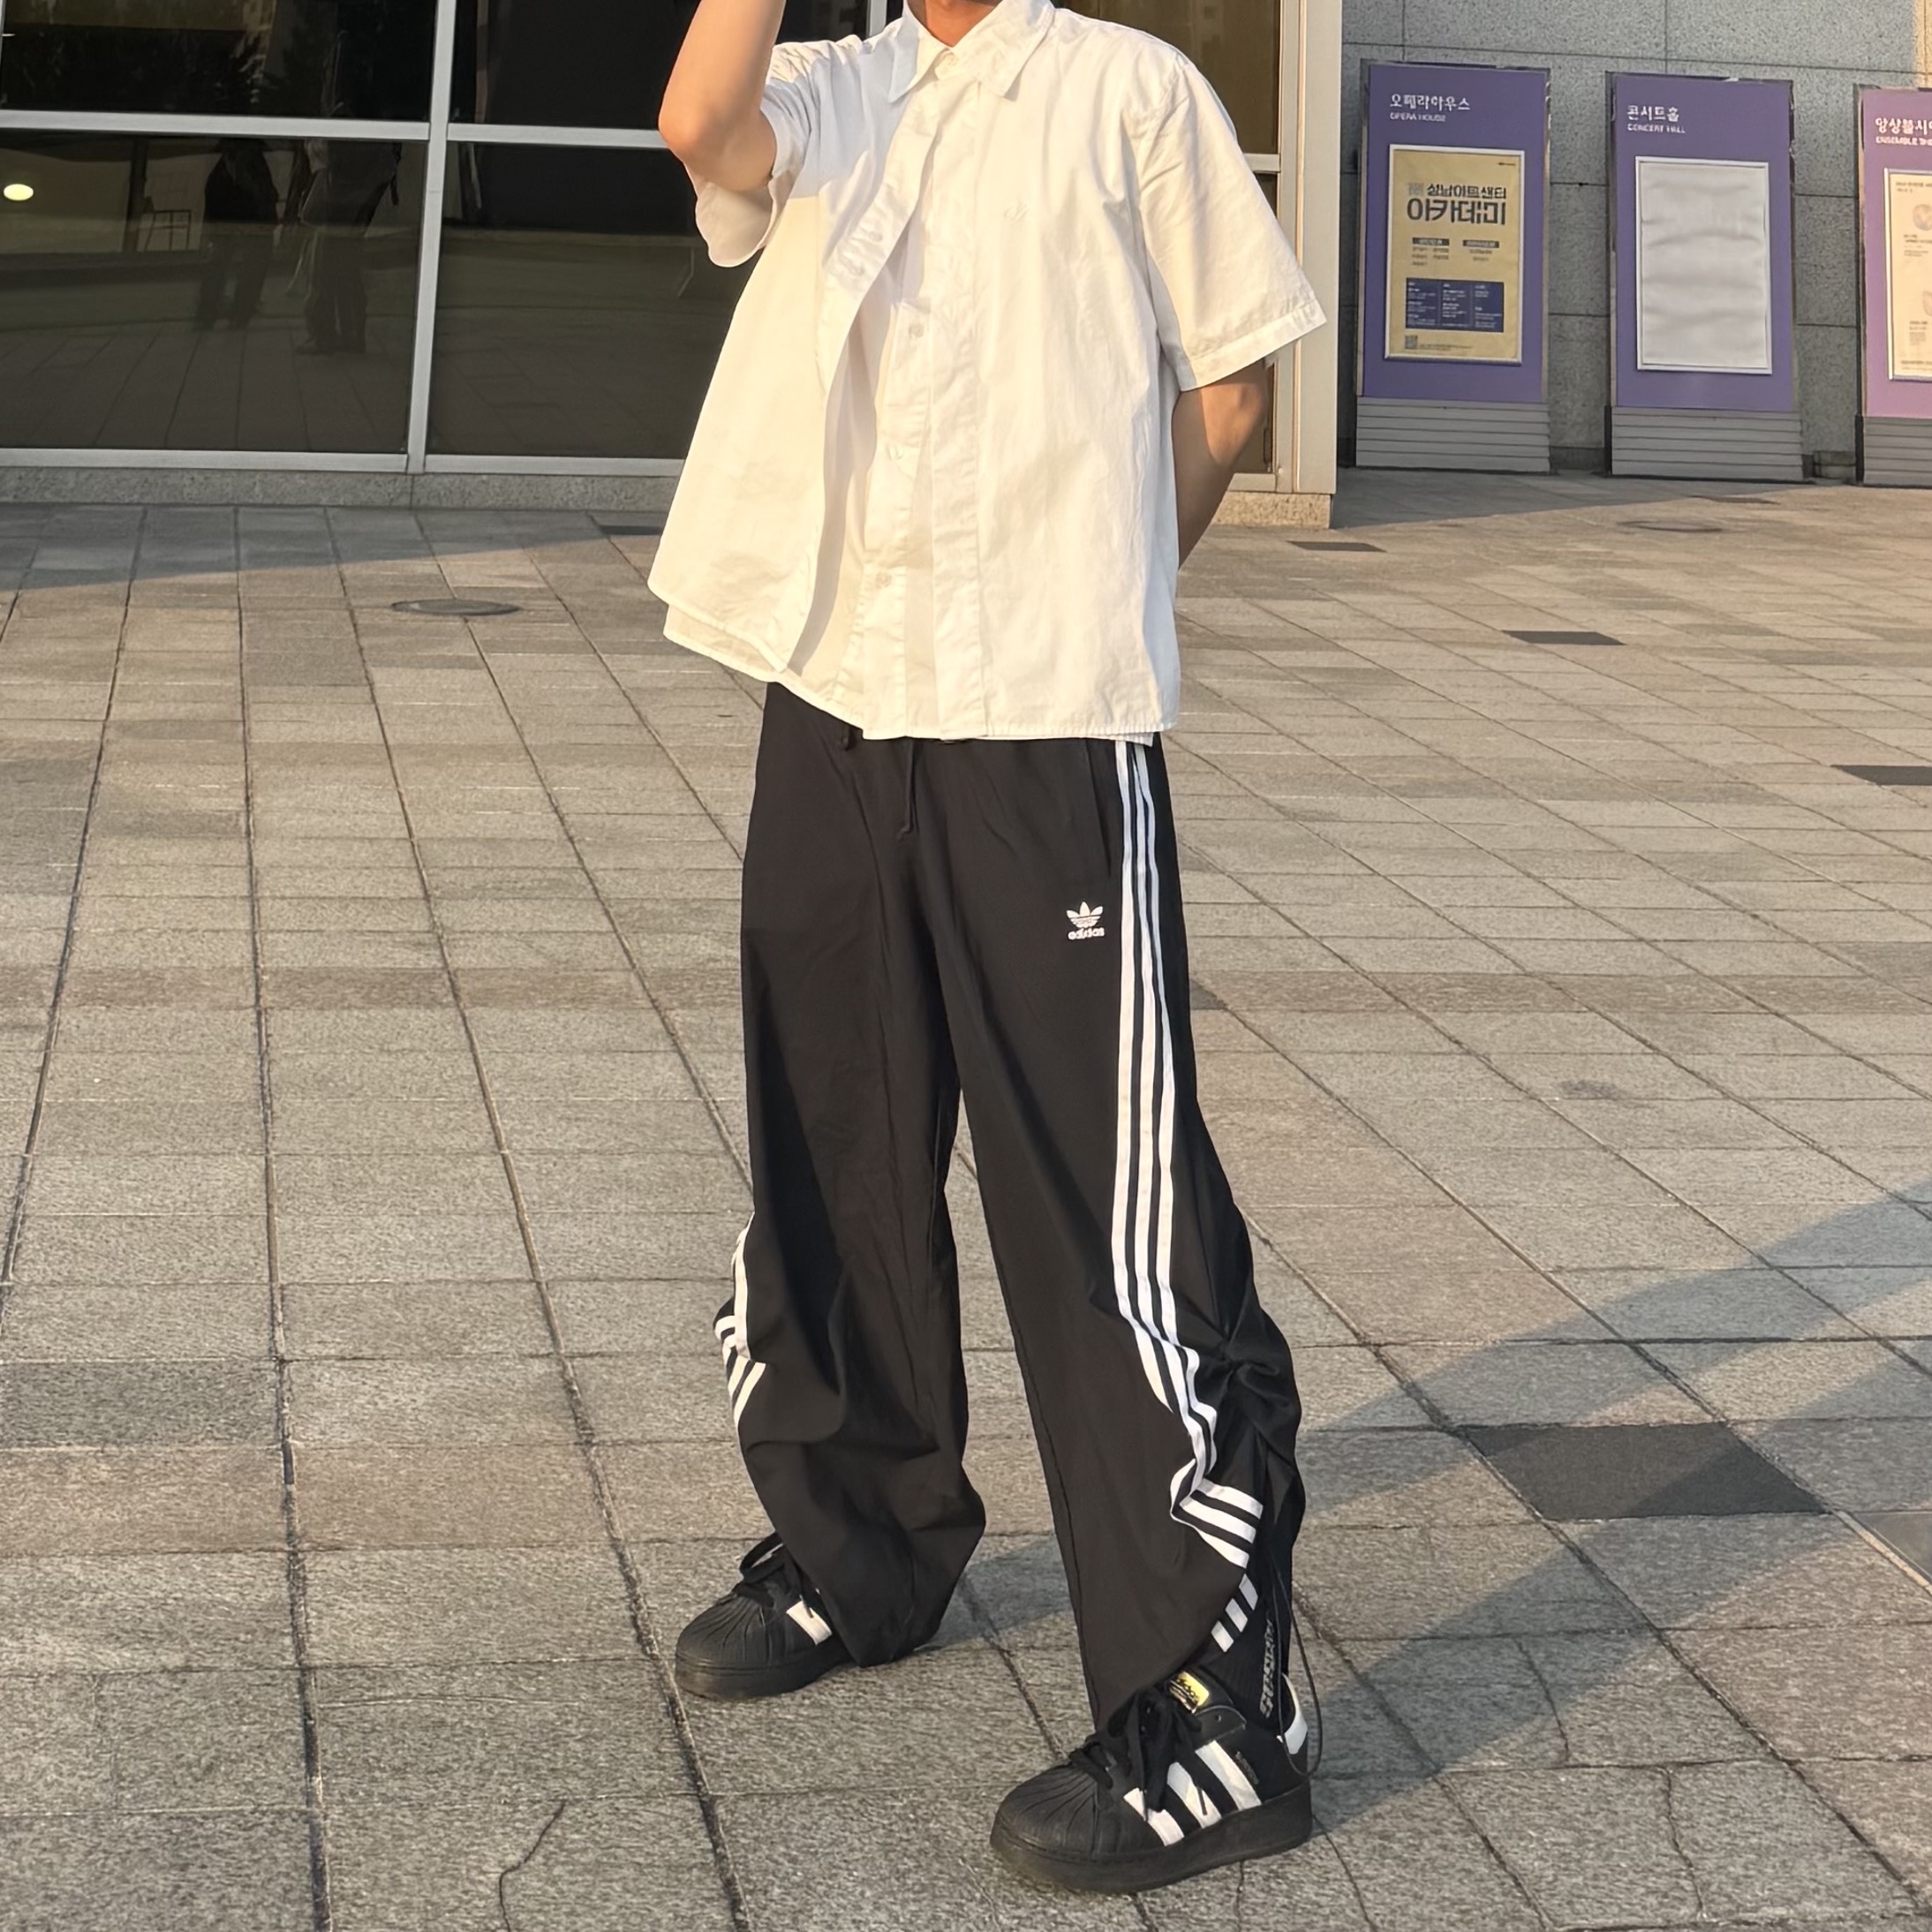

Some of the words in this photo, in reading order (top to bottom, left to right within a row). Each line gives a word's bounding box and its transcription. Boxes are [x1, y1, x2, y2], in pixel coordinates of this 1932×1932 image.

[1390, 94, 1470, 111] 오페라하우스
[1626, 105, 1679, 123] 콘서트홀
[1875, 117, 1932, 135] 앙상블시
[1407, 198, 1506, 225] 아카데미
[1068, 927, 1105, 940] adidas
